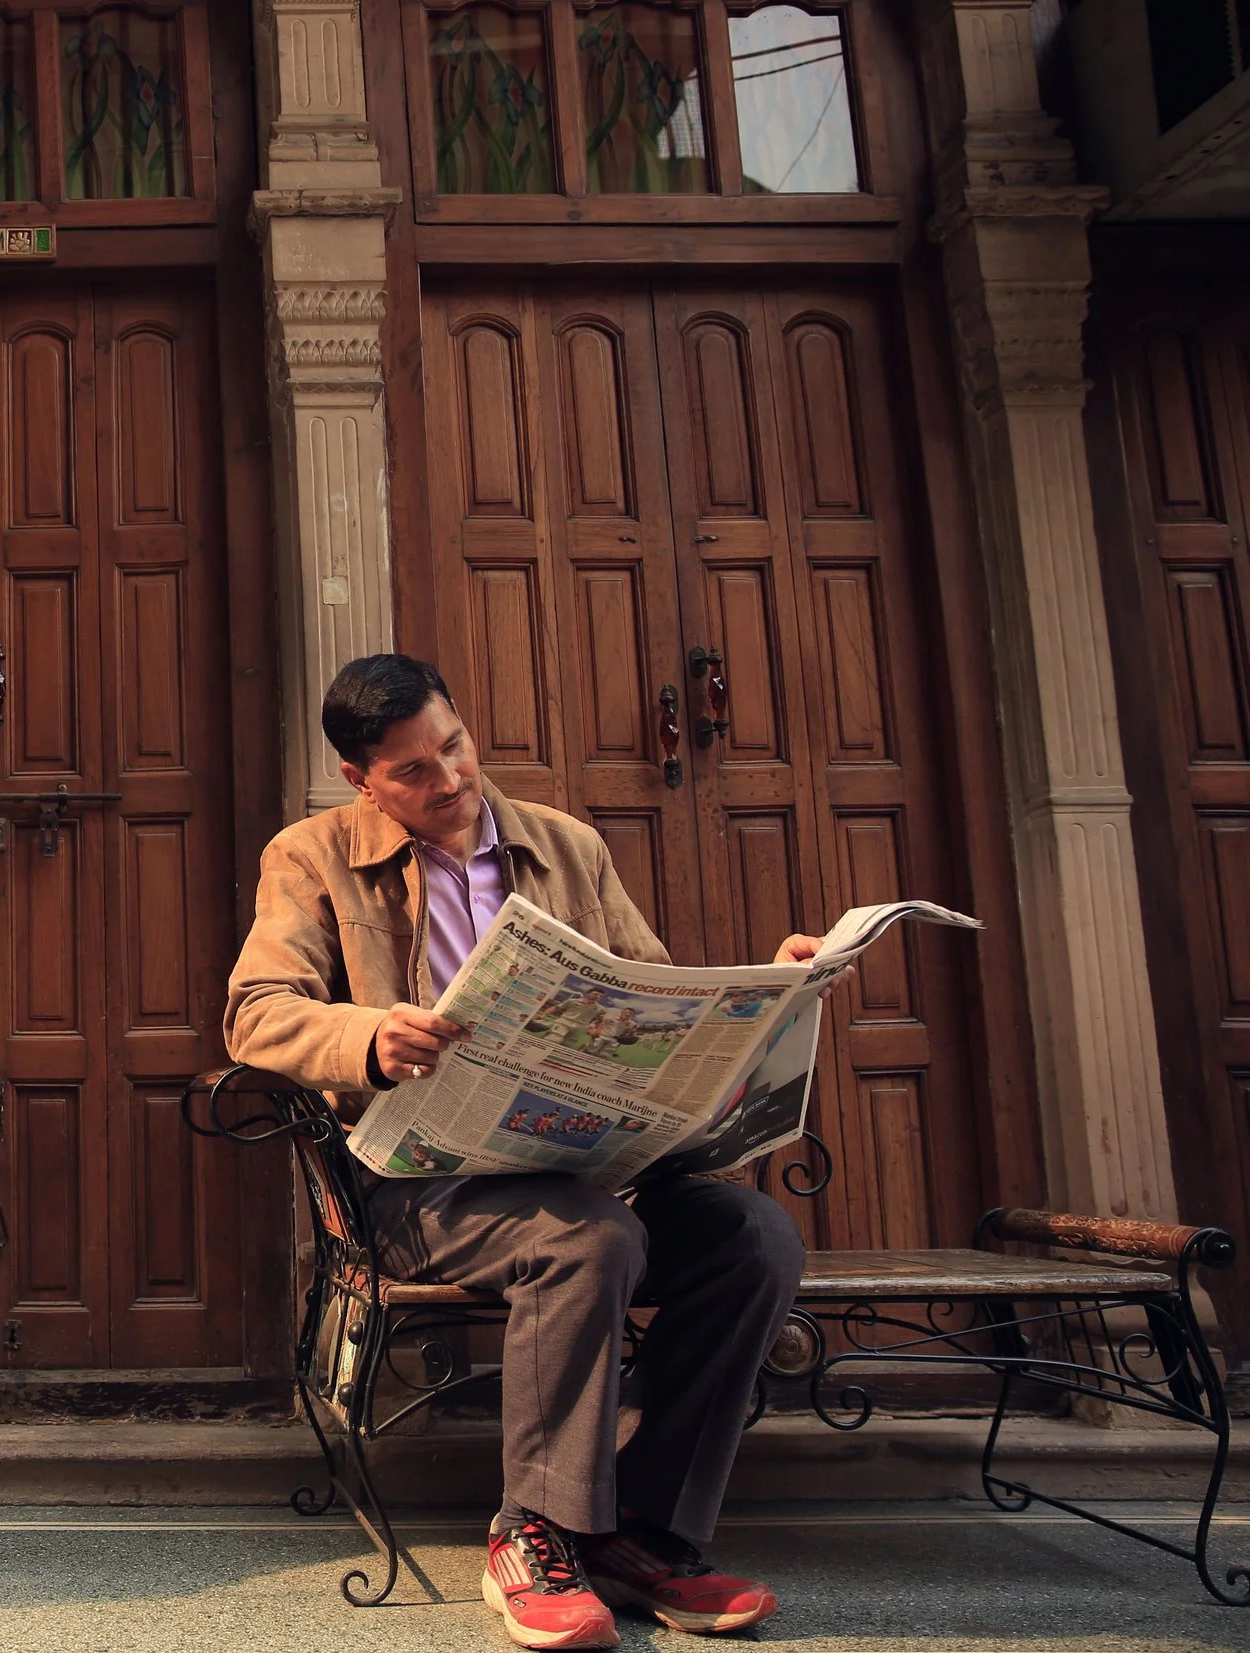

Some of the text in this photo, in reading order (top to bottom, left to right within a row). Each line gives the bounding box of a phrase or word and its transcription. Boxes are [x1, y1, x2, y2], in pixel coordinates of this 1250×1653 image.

[502, 921, 552, 956] Ashes:
[549, 949, 579, 972] Aus
[579, 965, 628, 989] Gabba
[628, 981, 679, 996] record
[676, 985, 720, 997] intact
[457, 1043, 479, 1058] First
[478, 1051, 498, 1064] real
[498, 1057, 541, 1079] challenge
[539, 1071, 555, 1084] for
[554, 1076, 574, 1089] new
[573, 1082, 596, 1098] India
[596, 1092, 623, 1107] coach
[622, 1099, 658, 1117] Marijne
[522, 1081, 533, 1090] KEY
[532, 1084, 558, 1098] PLAYERS
[568, 1096, 589, 1107] GLANCE
[411, 1120, 435, 1142] Pankaj
[434, 1138, 461, 1154] Advani
[461, 1149, 478, 1159] wins
